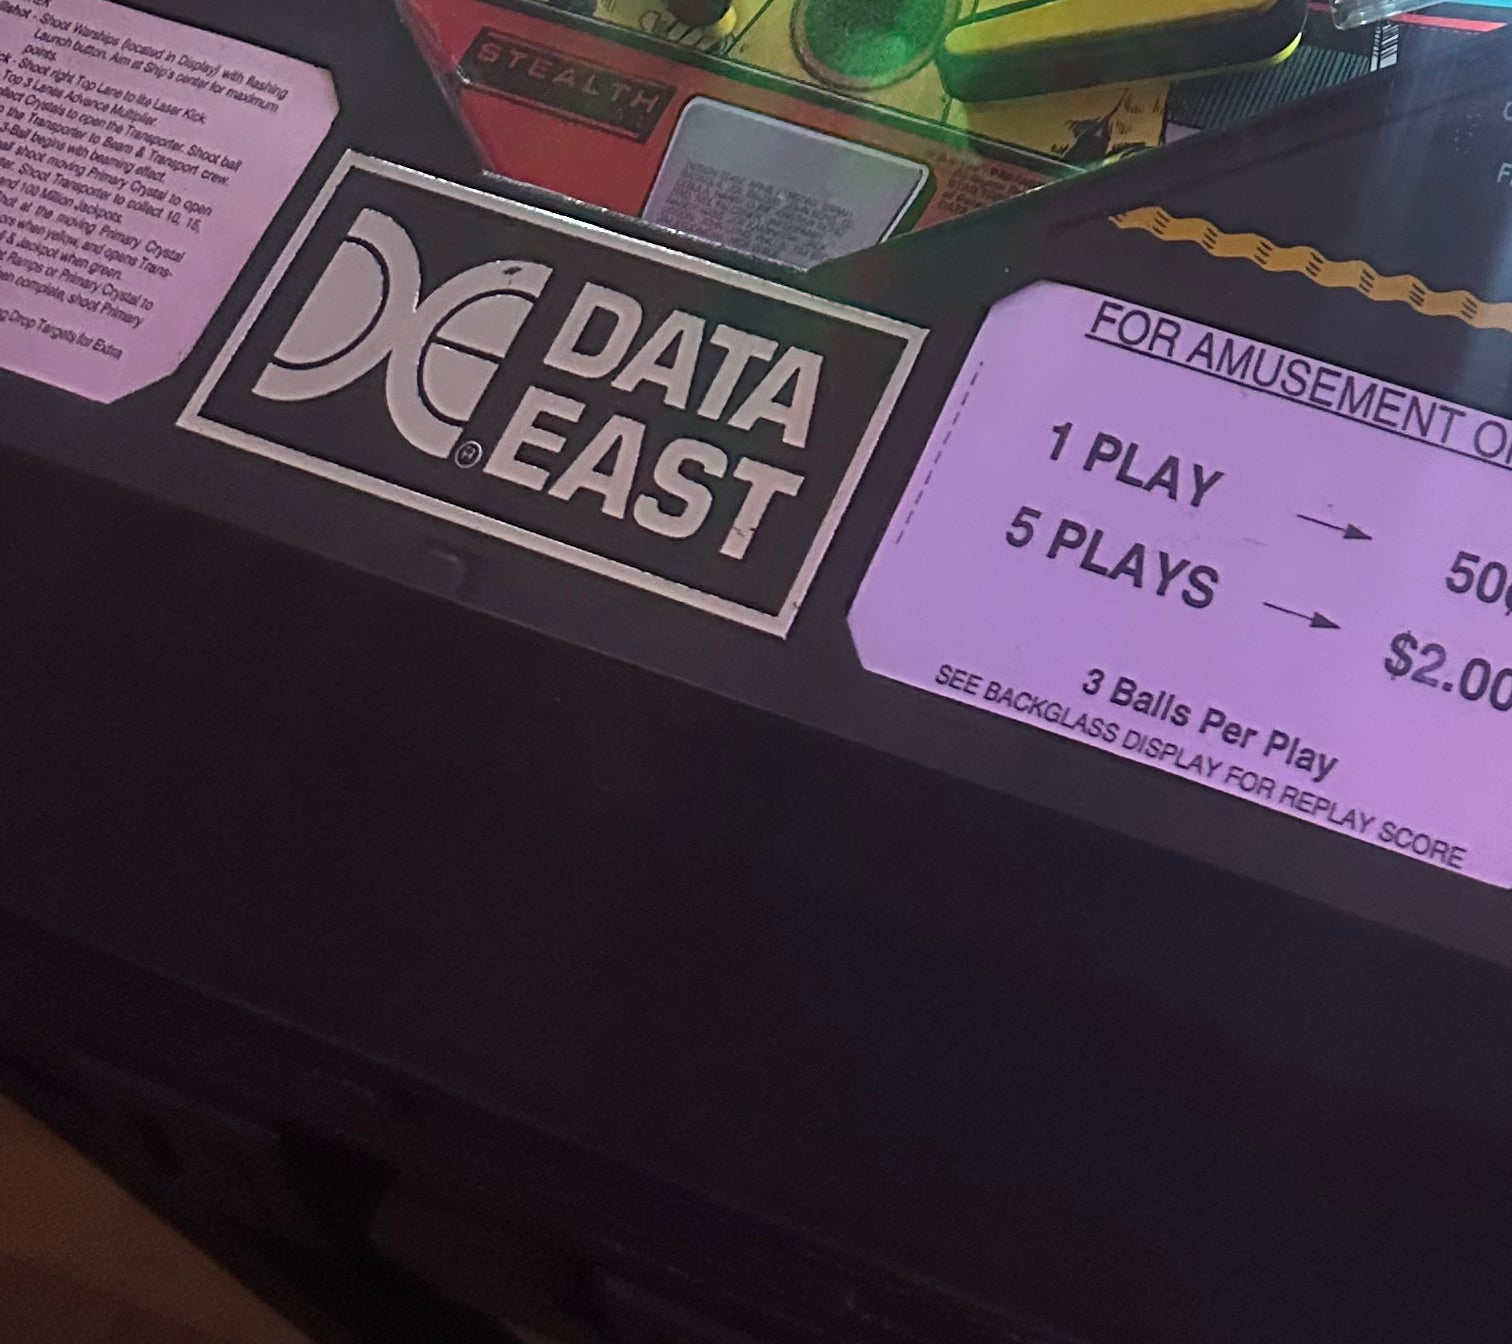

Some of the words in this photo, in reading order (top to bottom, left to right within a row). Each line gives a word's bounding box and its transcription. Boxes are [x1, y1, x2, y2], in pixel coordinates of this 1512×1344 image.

[34, 28, 72, 47] Launch
[144, 62, 175, 79] Ship's
[39, 13, 72, 31] Shoot
[73, 23, 120, 46] Warships
[177, 55, 221, 78] Display)
[222, 71, 244, 83] with
[475, 41, 662, 116] STEALTH
[18, 58, 51, 76] Shoot
[50, 69, 75, 84] right
[96, 82, 123, 99] Lane
[152, 99, 183, 115] Laser
[32, 79, 64, 98] Lanes
[64, 90, 109, 112] Advance
[24, 94, 66, 116] Crystals
[220, 156, 242, 172] ball
[30, 131, 66, 151] begins
[149, 149, 199, 175] Transport
[39, 188, 74, 207] Million
[16, 238, 60, 259] Jackpot
[8, 311, 36, 329] Drop
[37, 318, 77, 344] Targets
[92, 338, 122, 360] Extra
[543, 281, 824, 448] DATA
[1089, 300, 1179, 360] FOR
[1189, 326, 1467, 449] AMUSEMENT
[483, 384, 805, 560] EAST
[1050, 422, 1075, 461] 1
[1083, 431, 1225, 508] PLAY
[1005, 507, 1039, 550] 5
[1046, 521, 1221, 610] PLAYS
[1082, 668, 1104, 696] 3
[1110, 677, 1192, 729] Balls
[1199, 707, 1258, 751] Per
[1263, 726, 1339, 782] Play
[934, 663, 977, 694] SEE
[980, 677, 1122, 745] BACKGLASS
[1122, 721, 1225, 779] DISPLAY
[1224, 757, 1277, 799] FOR
[1279, 774, 1376, 833] REPLAY
[1379, 813, 1467, 870] SCORE
